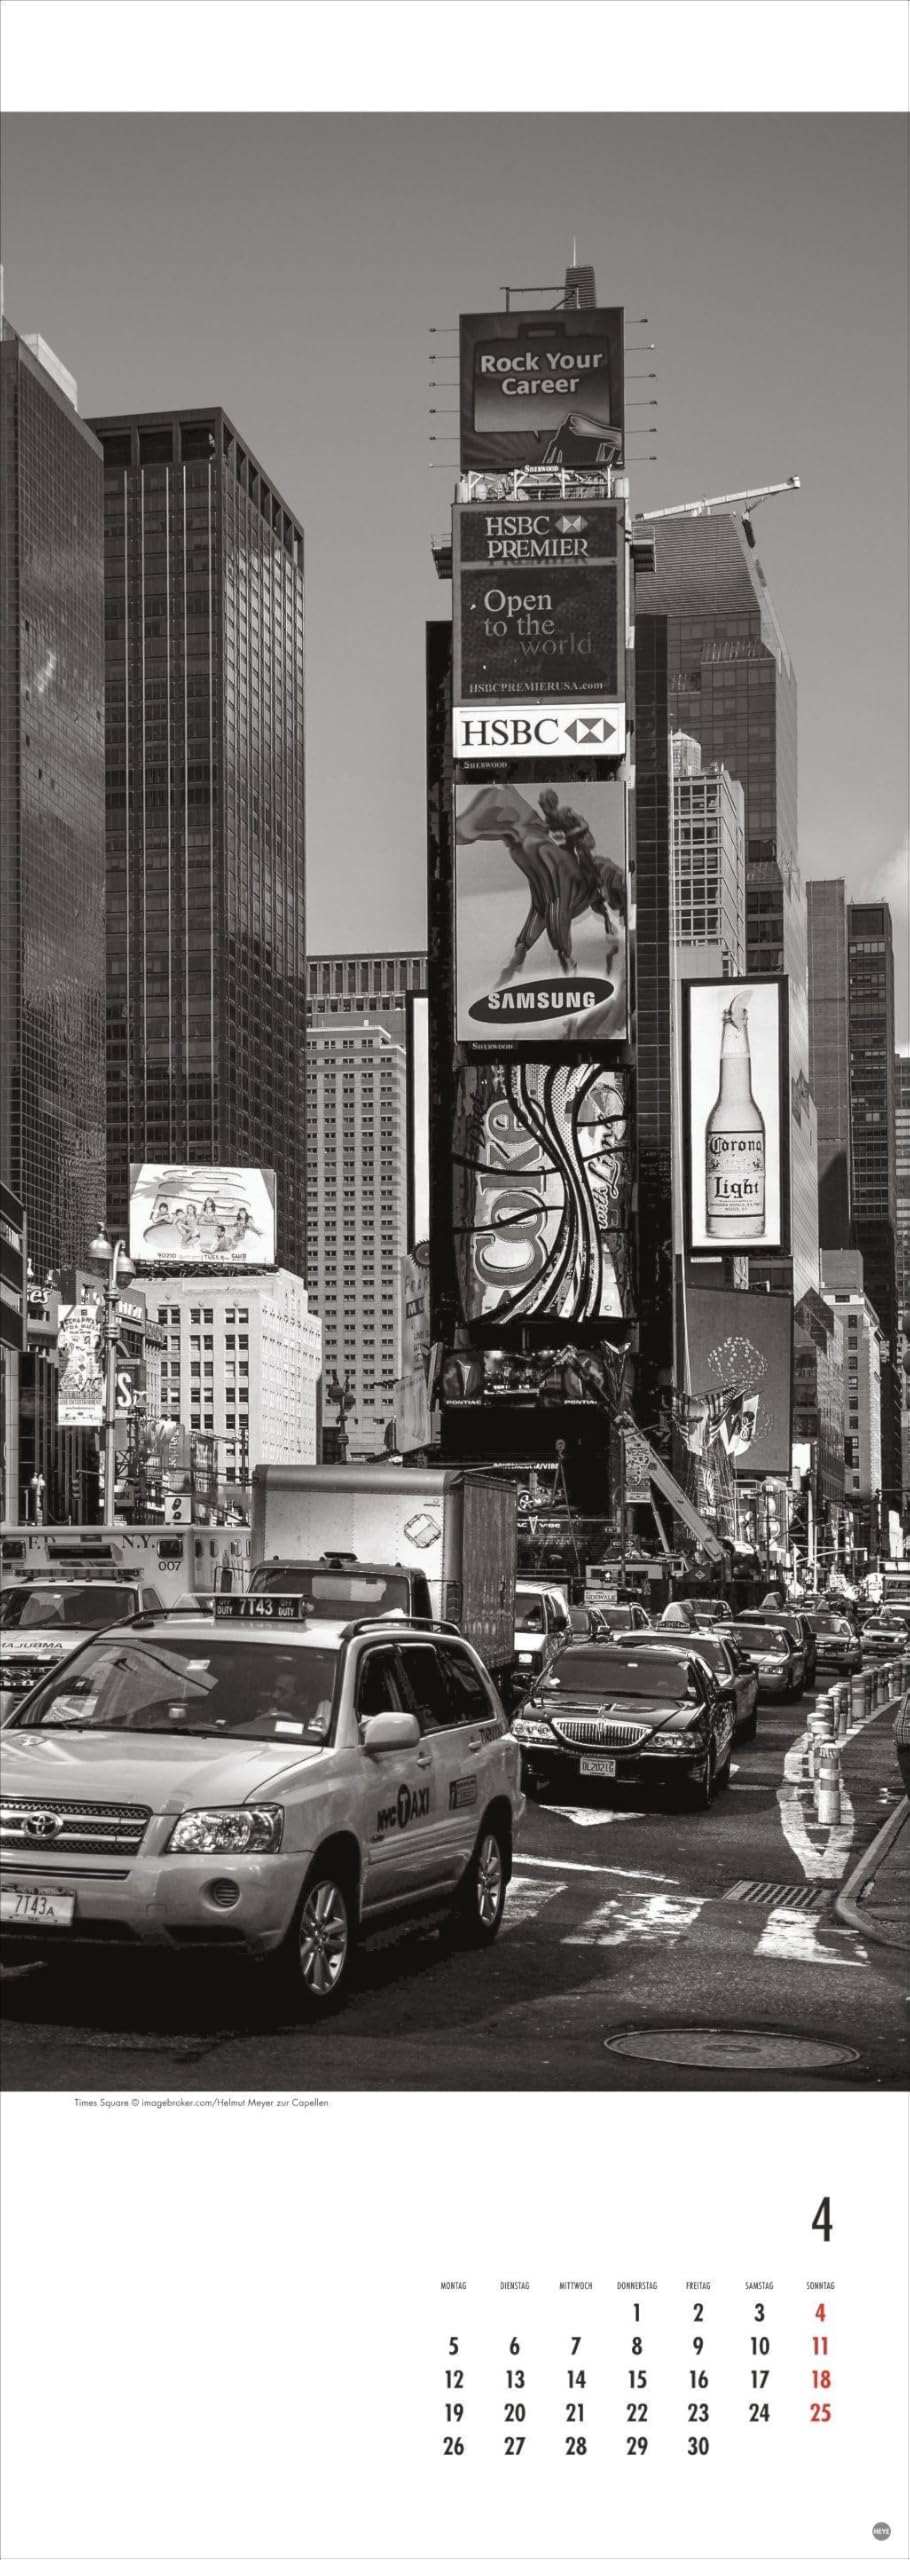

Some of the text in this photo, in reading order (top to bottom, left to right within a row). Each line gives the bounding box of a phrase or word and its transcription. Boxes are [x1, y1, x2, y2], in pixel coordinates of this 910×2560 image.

[480, 350, 604, 373] Rock Your
[501, 375, 580, 395] Career
[524, 464, 560, 473] SHERWOOD
[485, 515, 550, 536] HSBC
[487, 538, 590, 559] PREMIER
[484, 589, 553, 620] Open
[484, 613, 555, 638] to the
[520, 632, 593, 658] world
[469, 681, 604, 694] HSBCPREMIERUSA.com
[461, 718, 560, 746] HSBC
[463, 760, 508, 769] SHERWOOD
[487, 990, 596, 1010] SAMSUNG
[471, 1042, 514, 1051] SHERWOOD
[709, 1136, 762, 1155] Corona
[713, 1176, 760, 1199] Light
[158, 1561, 182, 1572] 007
[217, 1606, 233, 1615] DUTY
[240, 1598, 273, 1615] 7T43
[278, 1607, 295, 1617] DUTY
[377, 1784, 430, 1832] NYC TAXI
